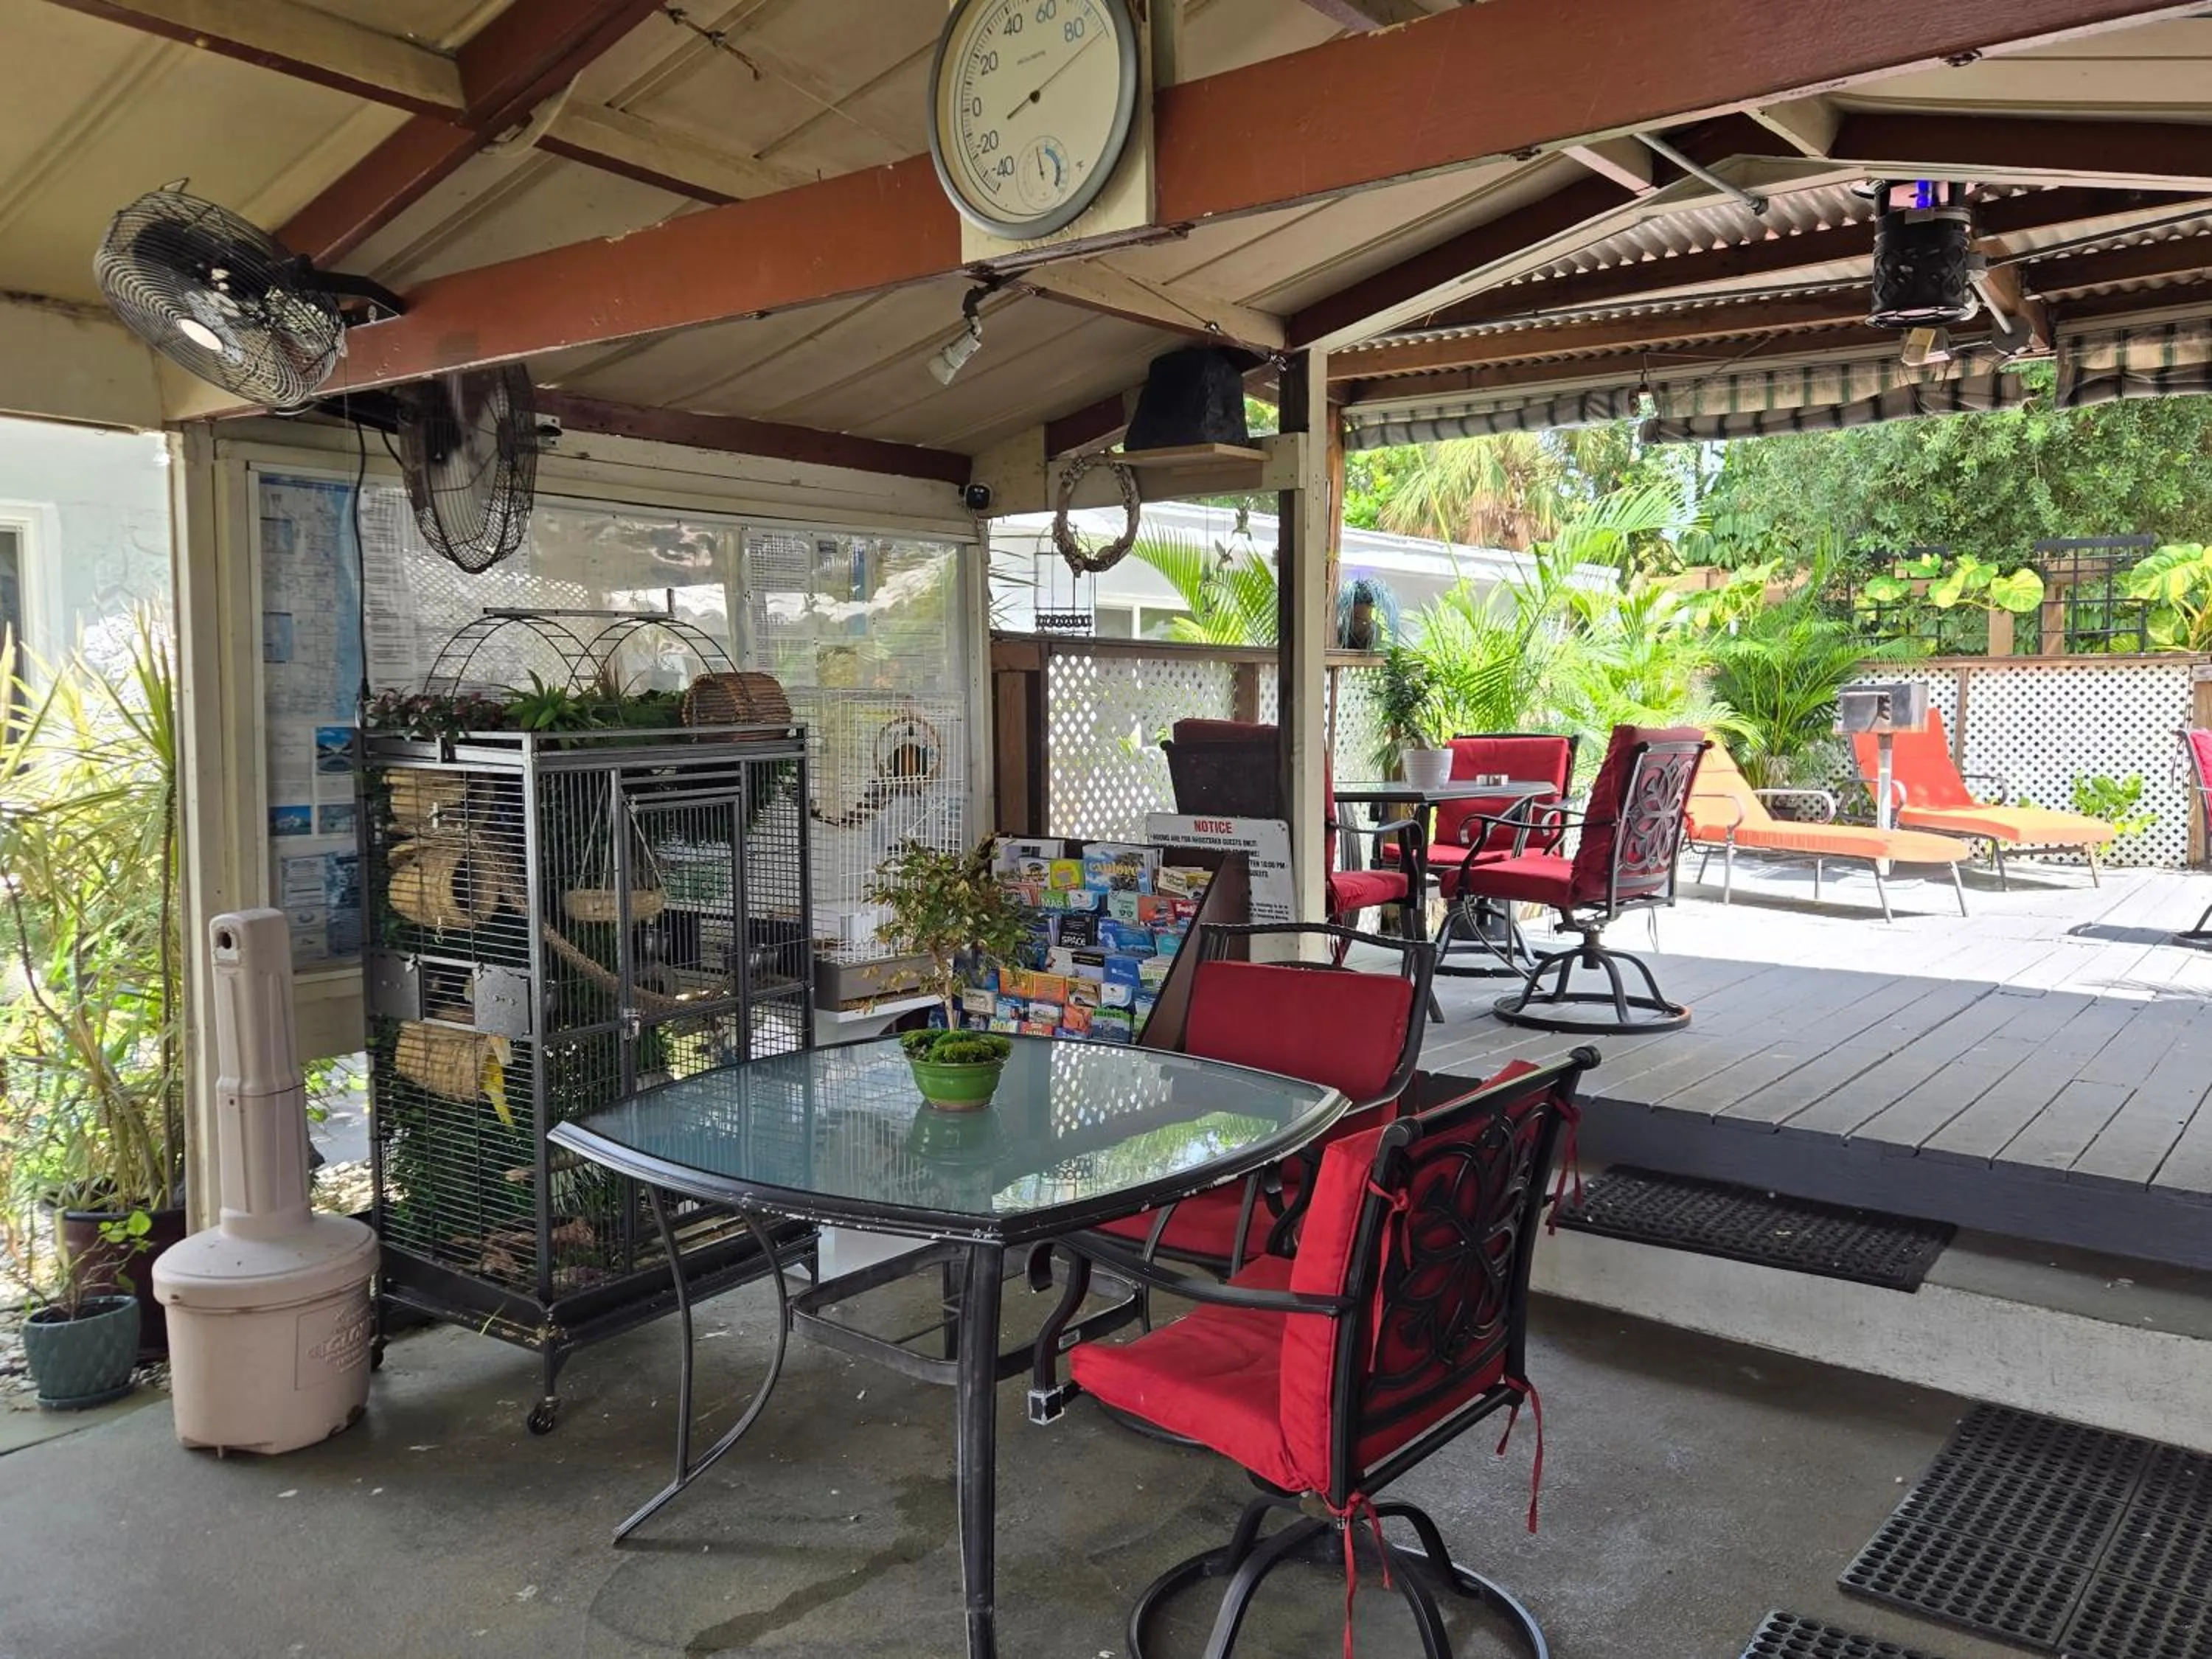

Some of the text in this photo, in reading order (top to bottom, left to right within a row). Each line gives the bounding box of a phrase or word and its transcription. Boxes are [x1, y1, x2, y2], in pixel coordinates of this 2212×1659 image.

[1036, 0, 1056, 23] 60
[1004, 13, 1023, 35] 40
[1065, 17, 1084, 42] 80
[981, 52, 998, 76] 20
[973, 97, 981, 116] 0
[977, 130, 998, 153] -20
[992, 156, 1015, 178] -40
[1194, 820, 1233, 834] NOTICE
[1062, 936, 1086, 946] SPACE
